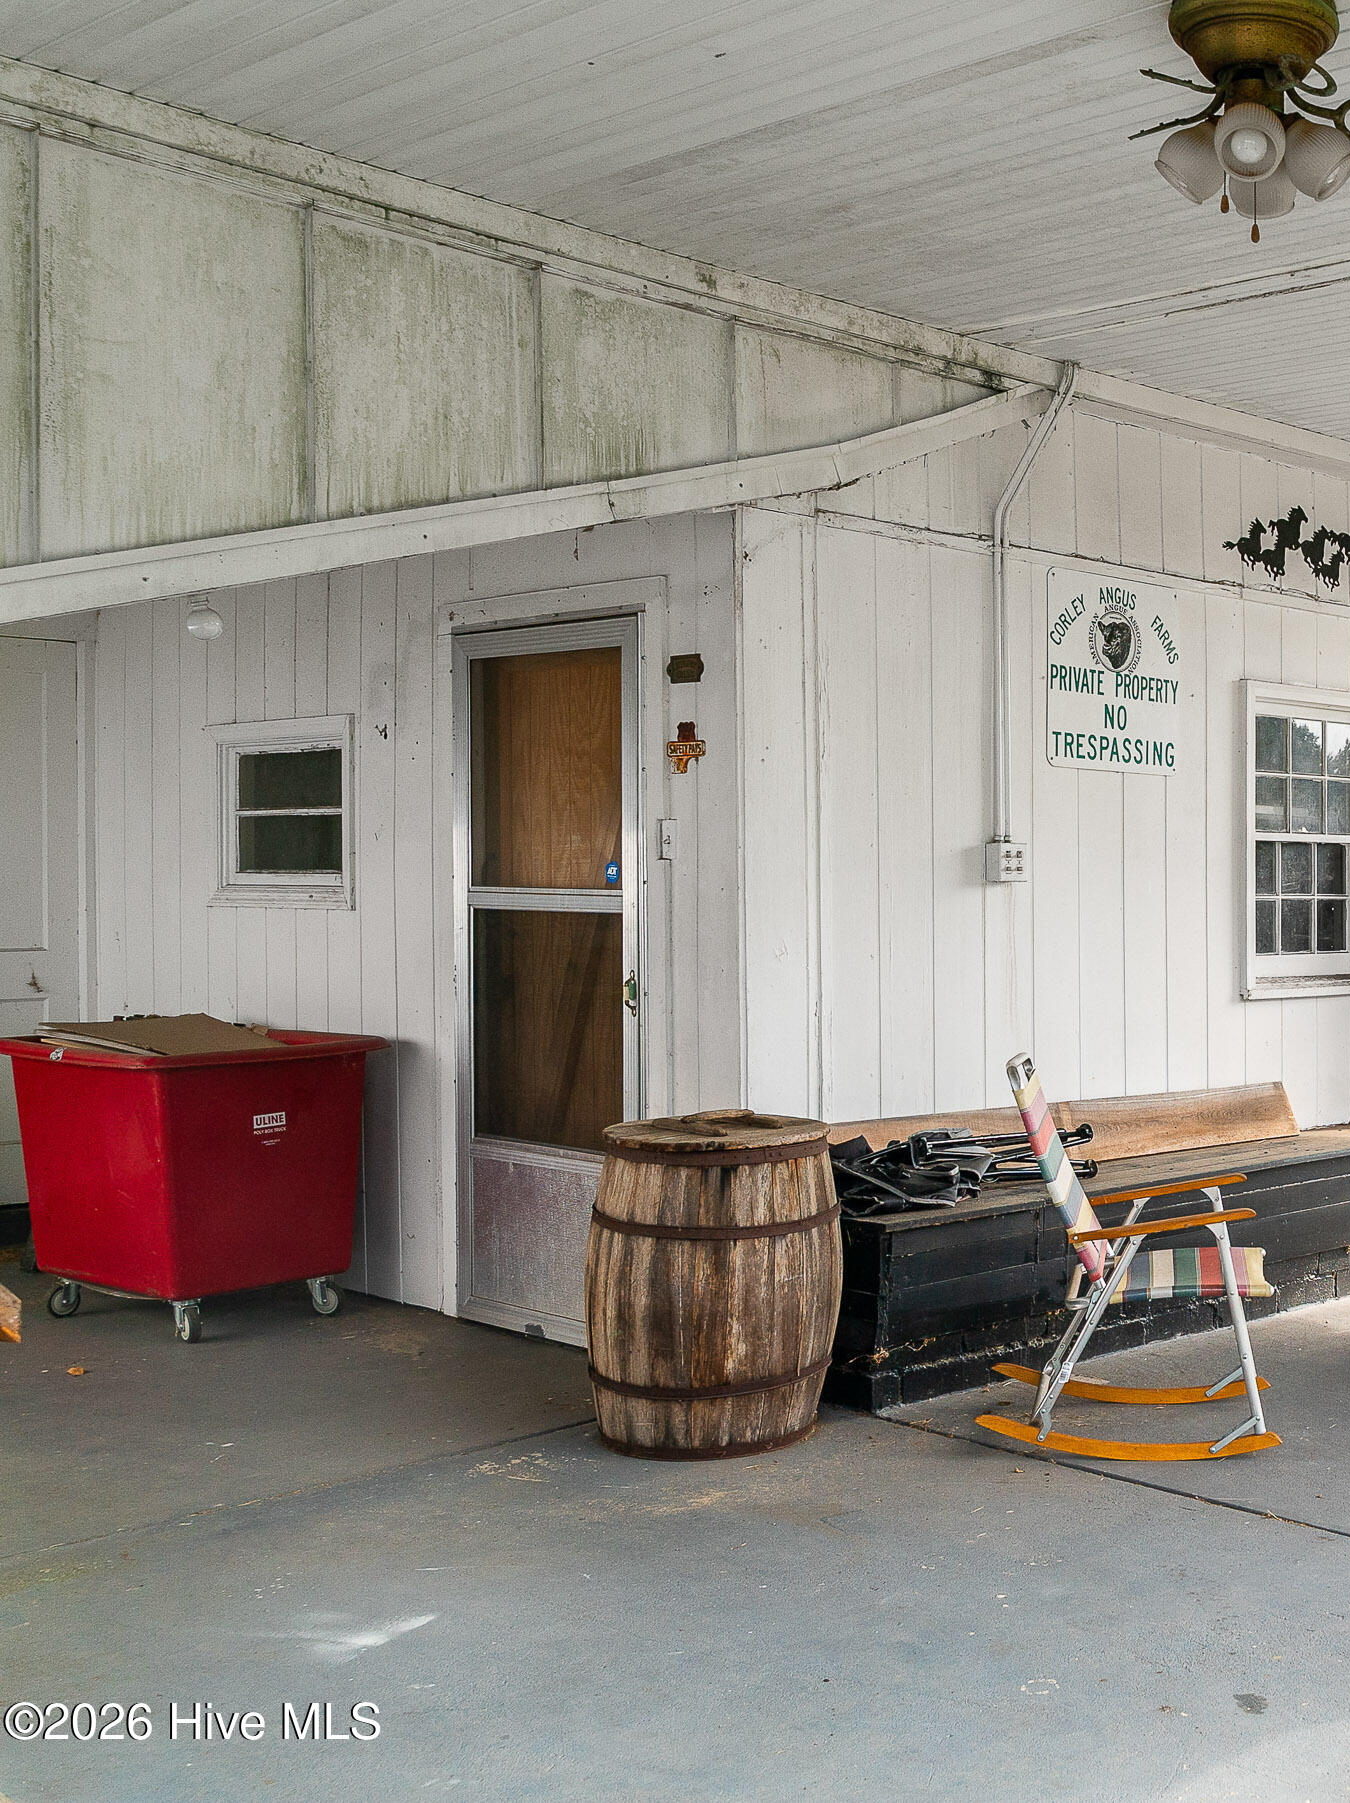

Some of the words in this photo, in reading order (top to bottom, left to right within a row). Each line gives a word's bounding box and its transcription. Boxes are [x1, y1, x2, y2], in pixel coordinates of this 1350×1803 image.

[1050, 593, 1087, 646] CORLEY
[1100, 586, 1137, 610] ANGUS
[1150, 614, 1180, 665] FARMS
[1088, 613, 1101, 665] AMERICAN
[1050, 663, 1105, 696] PRIVATE
[1115, 671, 1179, 705] PROPERTY
[1104, 703, 1128, 731] NO
[1052, 731, 1176, 768] TRESPASSING
[255, 1114, 284, 1126] ULINE
